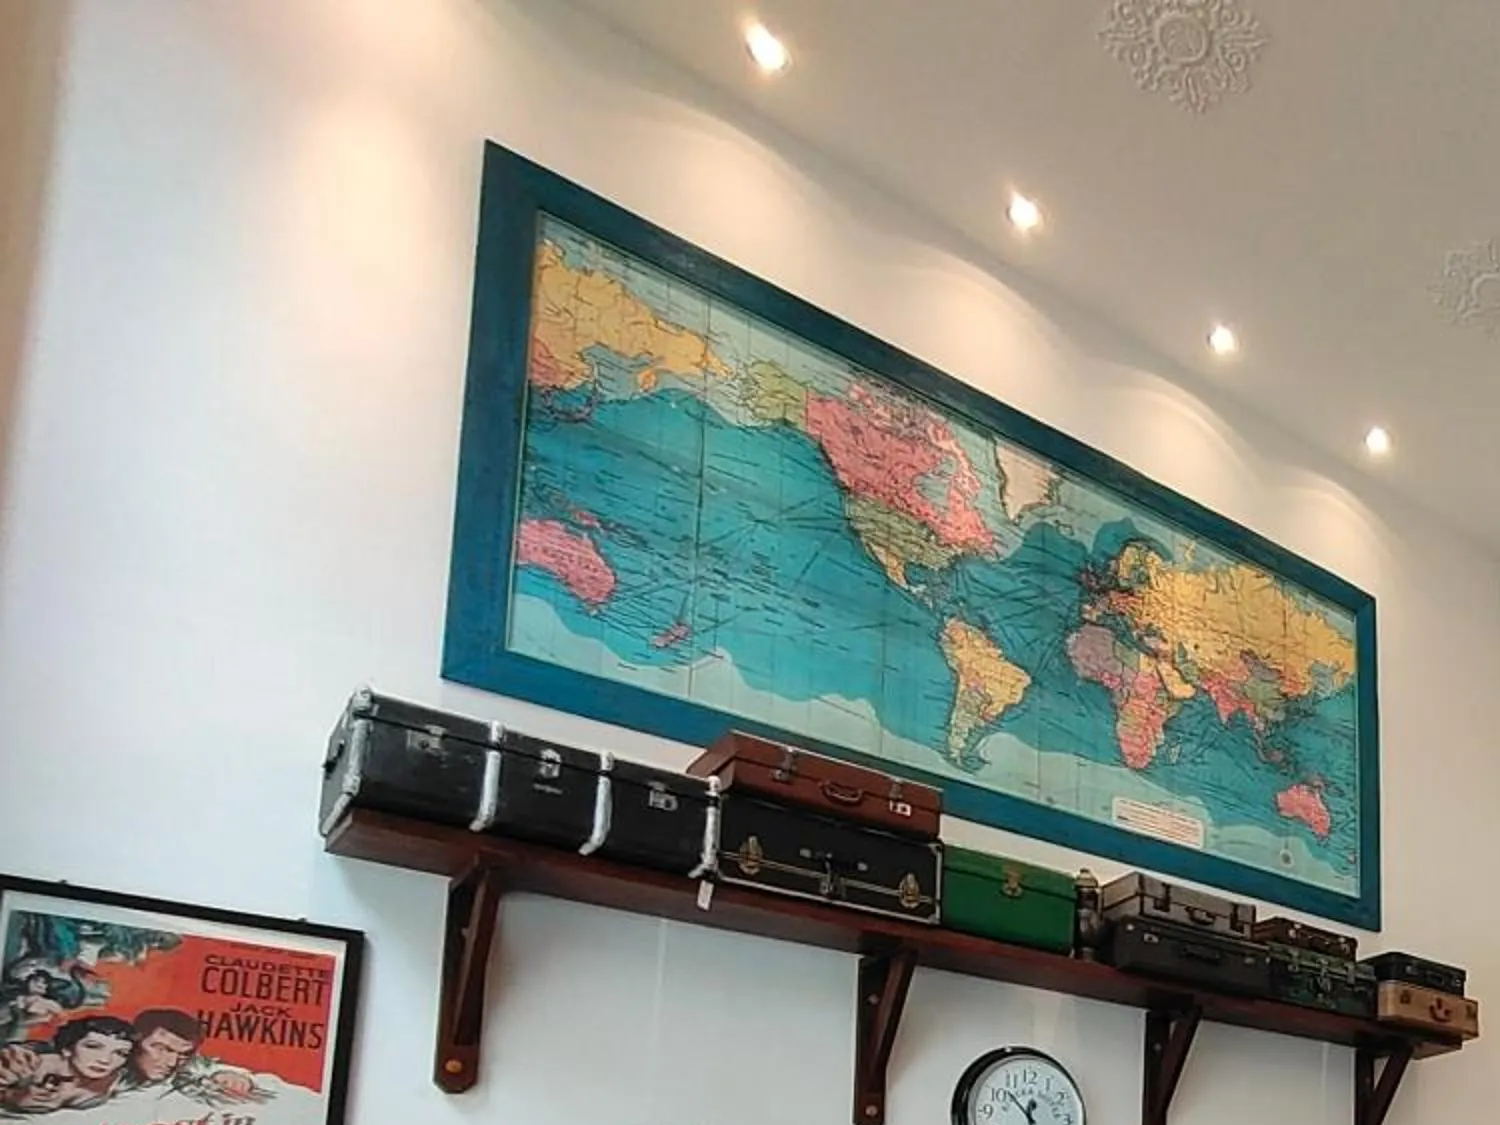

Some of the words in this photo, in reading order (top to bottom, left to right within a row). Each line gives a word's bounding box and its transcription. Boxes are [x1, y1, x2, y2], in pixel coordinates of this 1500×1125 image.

[204, 953, 331, 979] CLAUDETTE
[201, 965, 331, 1006] COLBERT
[229, 1002, 292, 1019] JACK
[197, 1009, 325, 1050] HAWKINS
